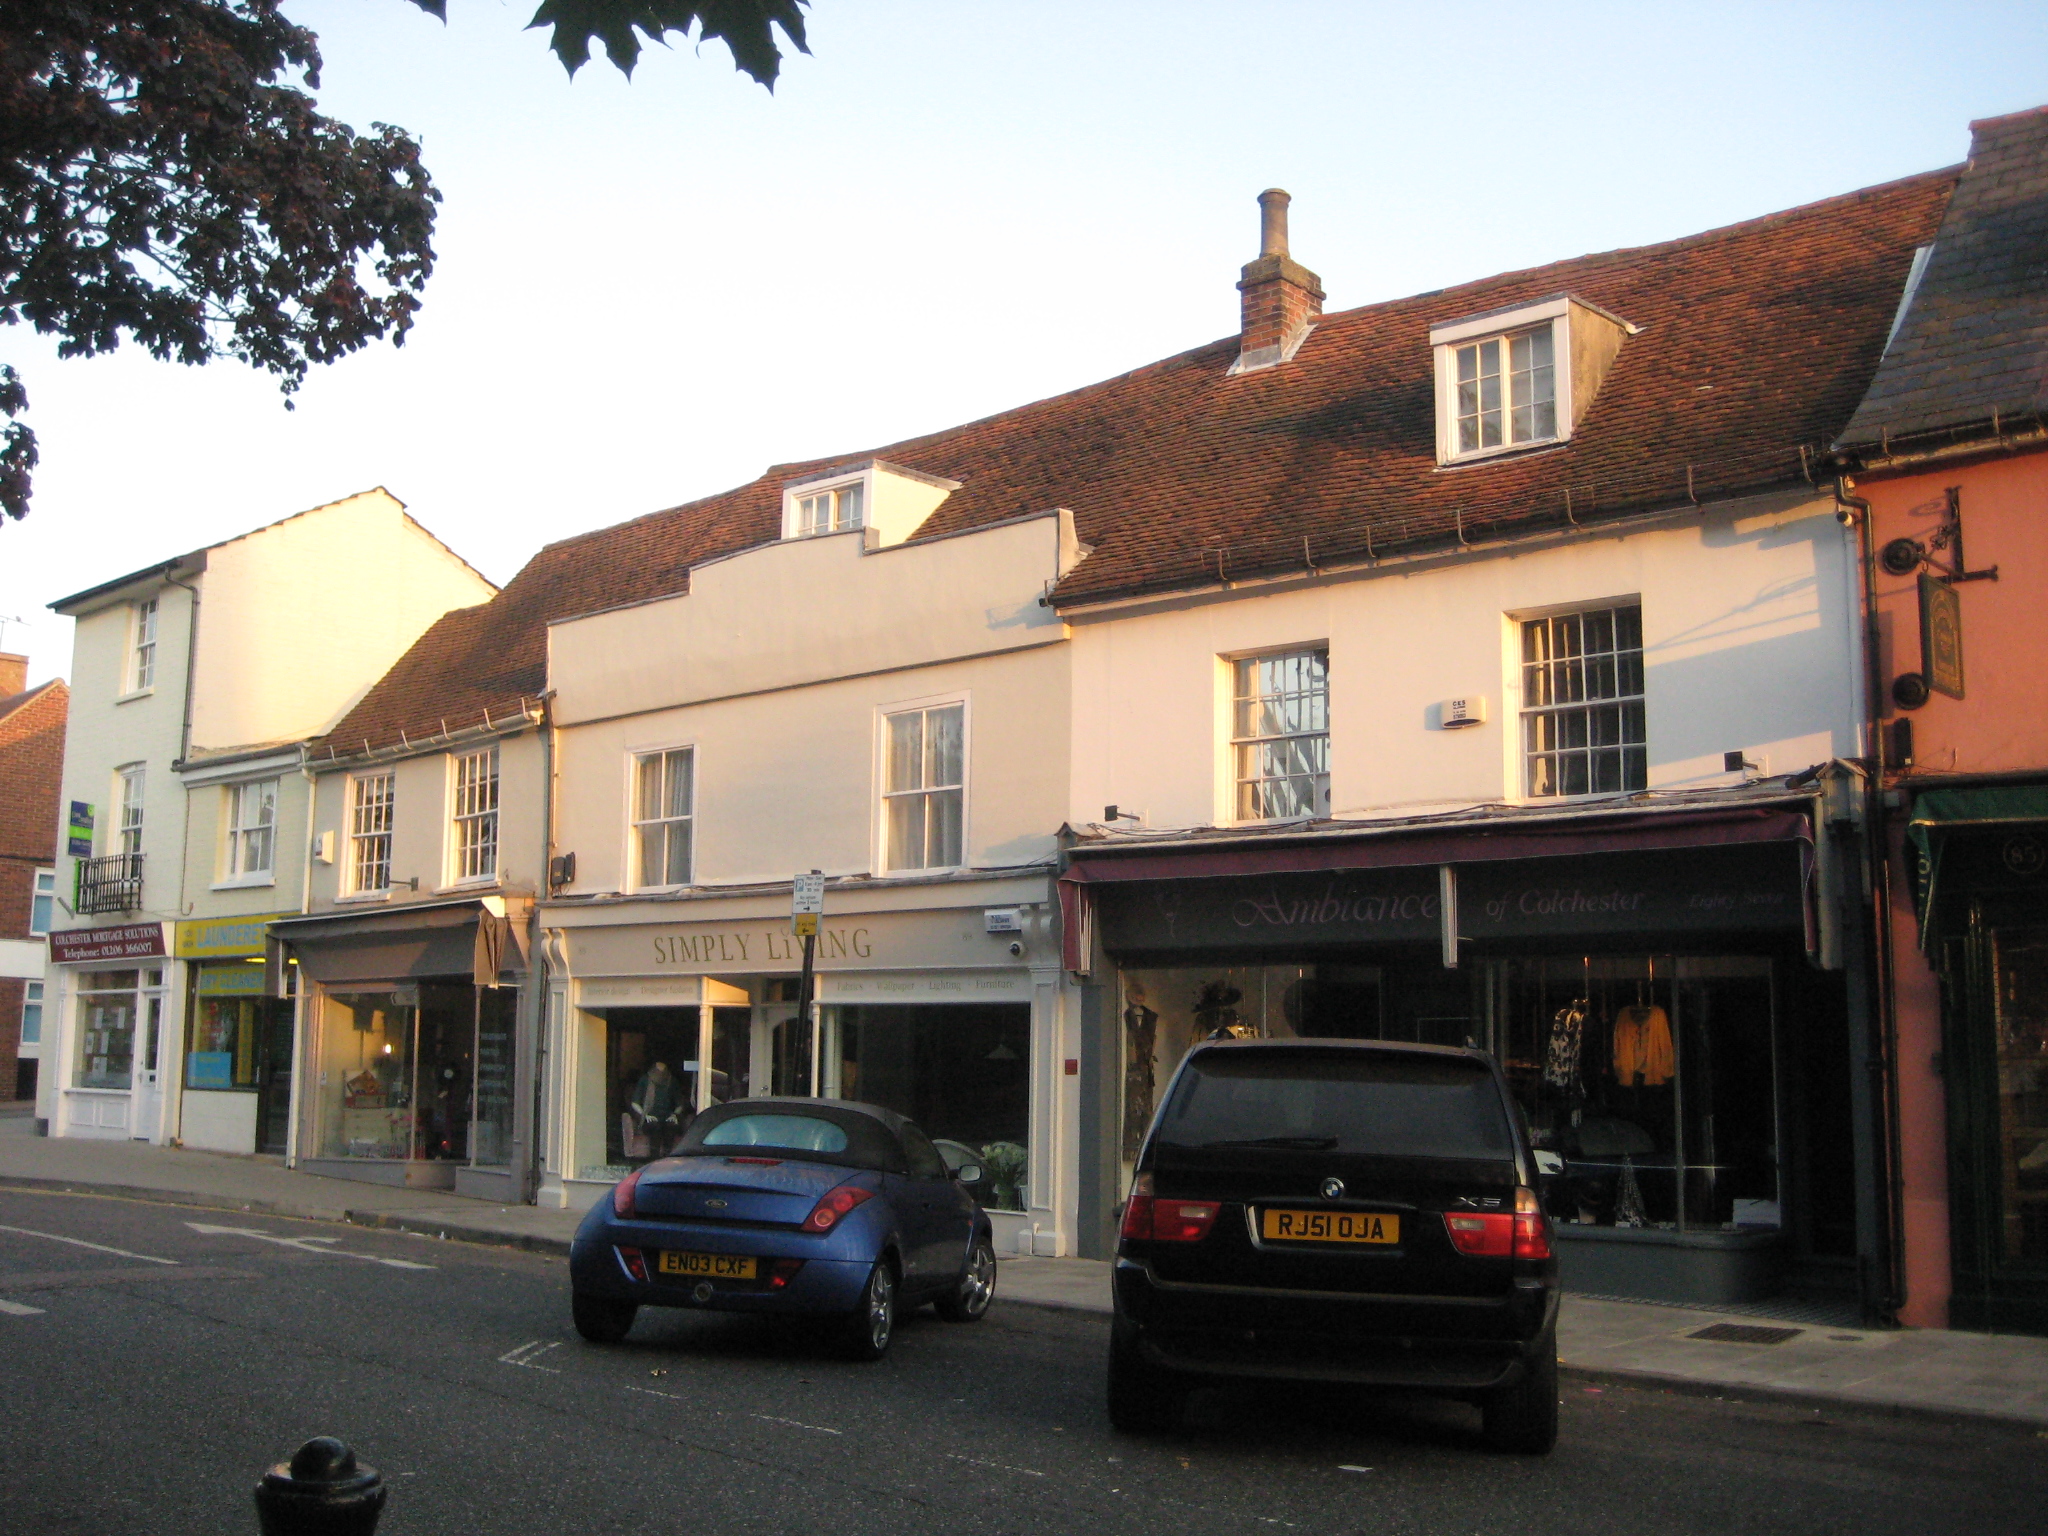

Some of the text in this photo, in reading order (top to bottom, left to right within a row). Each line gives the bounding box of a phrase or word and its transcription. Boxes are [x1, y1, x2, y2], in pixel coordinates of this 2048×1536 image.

[1232, 883, 1440, 927] Ambiance
[1485, 890, 1647, 922] of Colchester
[55, 926, 159, 946] COLCHESTER MORTGAGE SOLUTIONS
[63, 942, 152, 960] Telephone: 01206 366007
[653, 933, 751, 964] SIMPLY
[837, 978, 1015, 992] Fabrics Wallpaper Lighting Furniture
[1454, 1196, 1502, 1208] X5
[1278, 1213, 1385, 1240] RJ51 OJA
[667, 1253, 749, 1275] EN03 CXF
